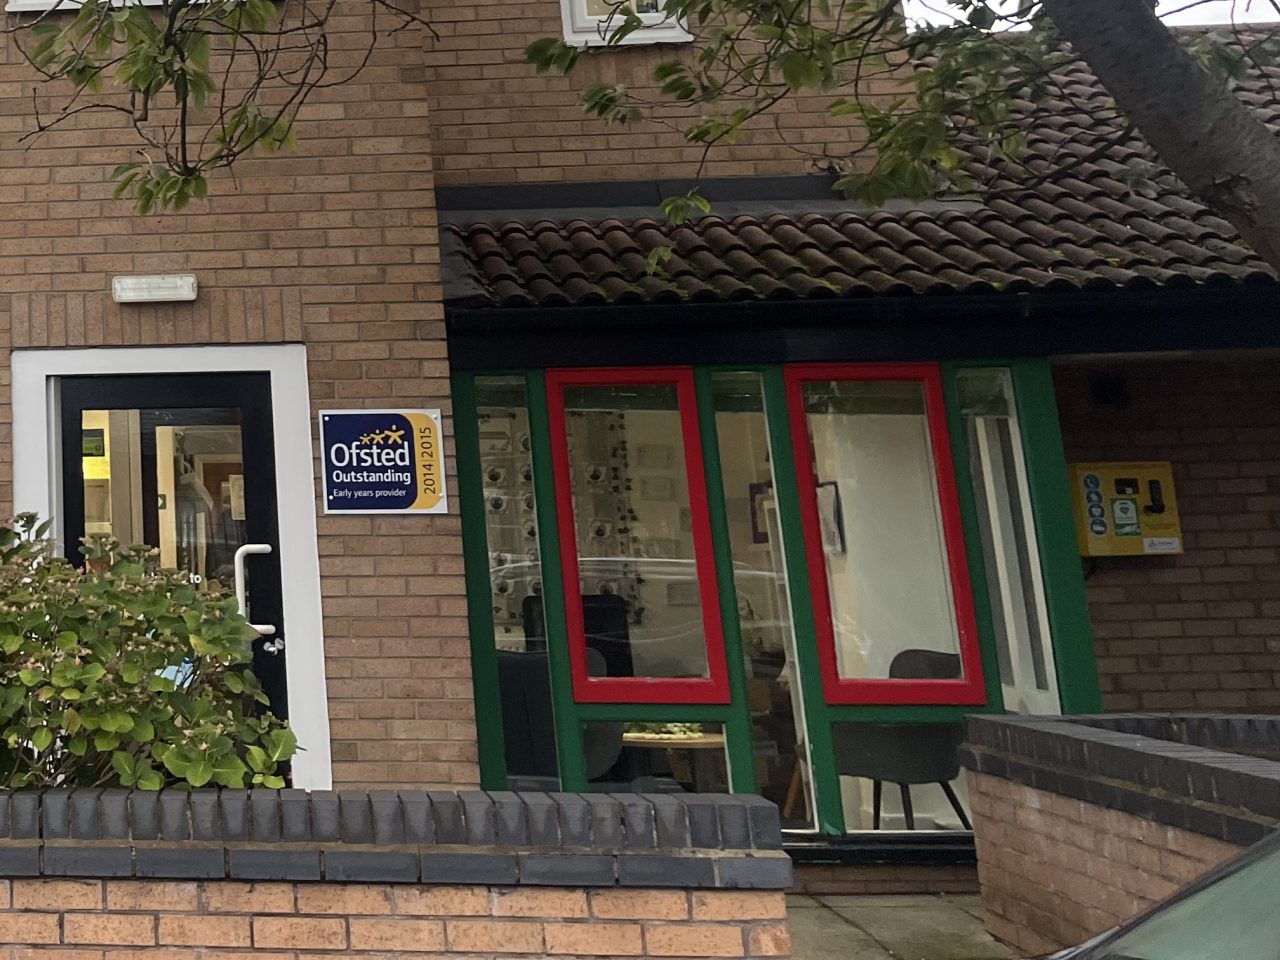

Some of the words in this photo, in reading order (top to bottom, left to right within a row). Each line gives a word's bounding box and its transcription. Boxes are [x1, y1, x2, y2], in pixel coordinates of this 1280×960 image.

[330, 441, 410, 467] Ofsted
[332, 469, 411, 485] Outstanding
[333, 489, 352, 499] Early
[353, 490, 374, 500] years
[375, 489, 406, 500] provider
